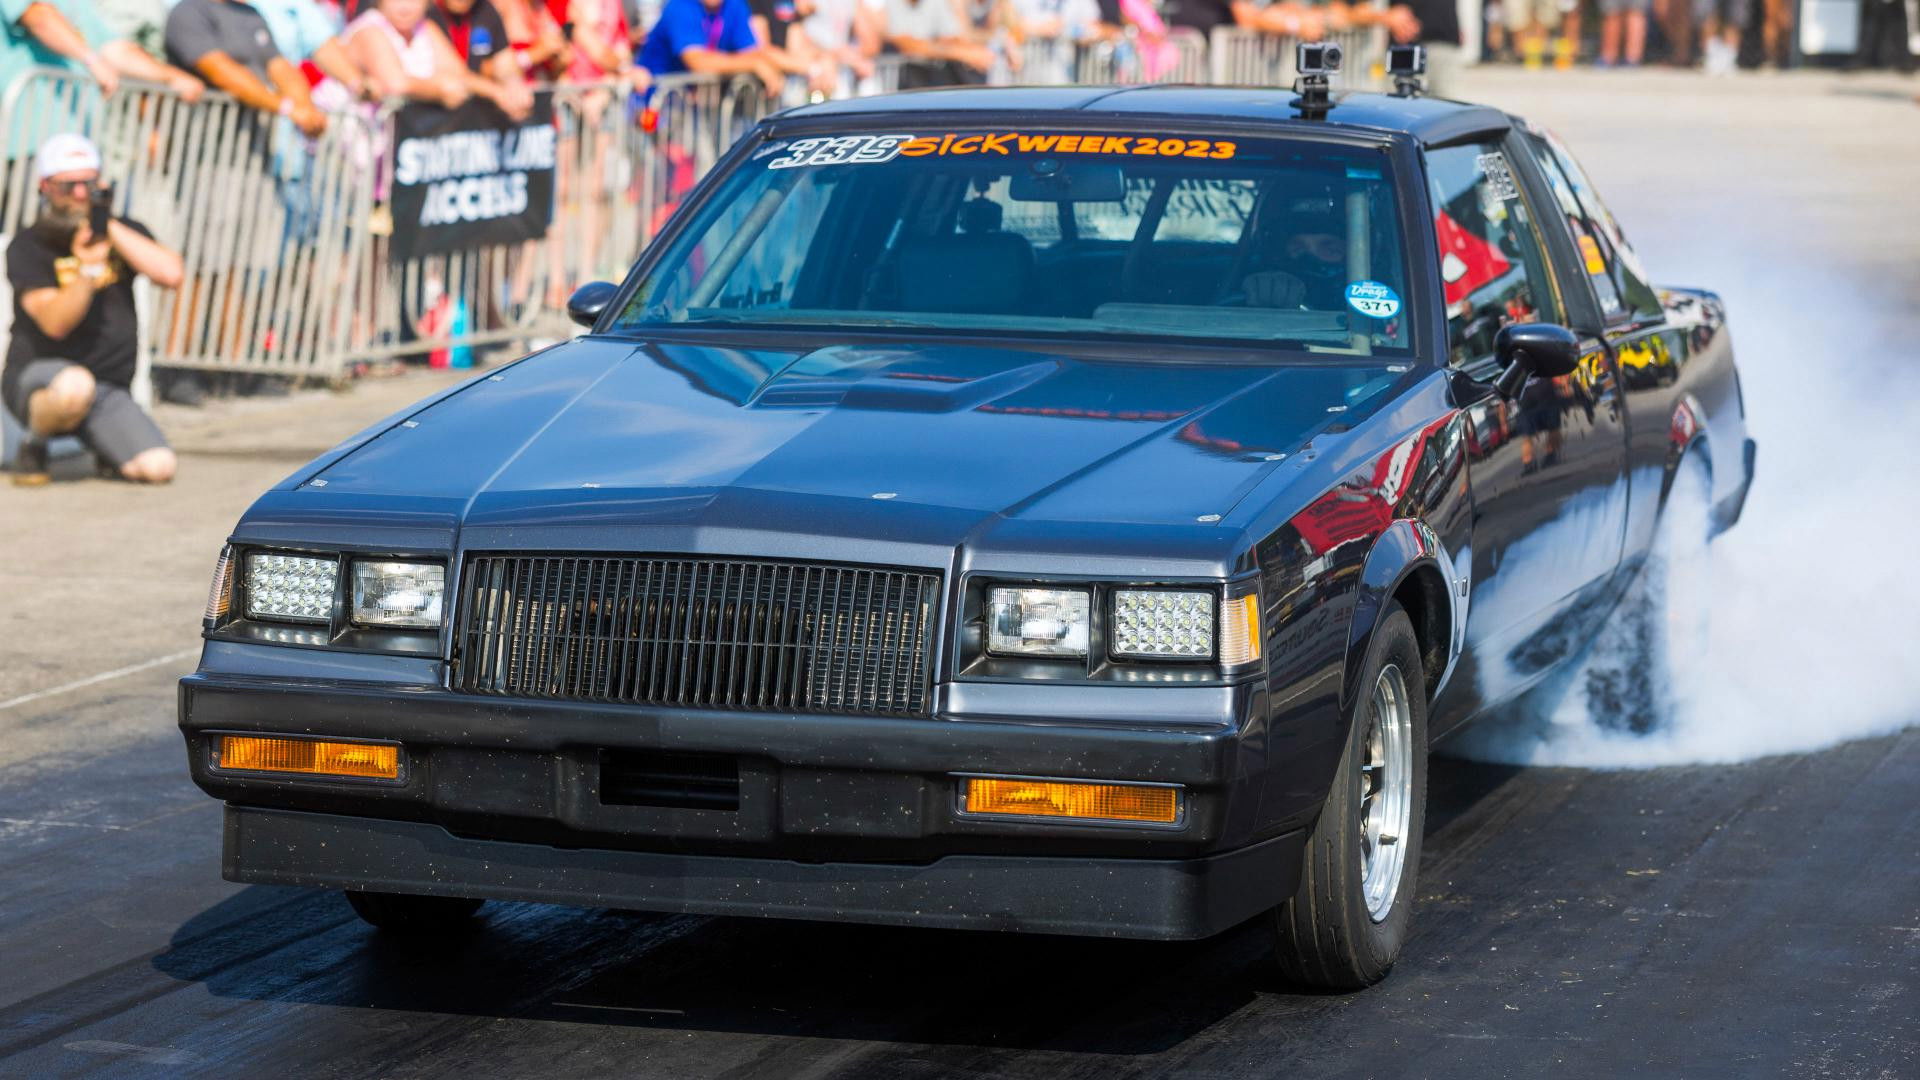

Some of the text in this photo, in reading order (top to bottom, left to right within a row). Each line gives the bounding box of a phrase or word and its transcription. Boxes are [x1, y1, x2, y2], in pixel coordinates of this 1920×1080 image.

[768, 134, 916, 169] 339
[1018, 135, 1134, 154] WEEK
[1132, 137, 1237, 159] 2023
[420, 172, 528, 226] ACCESS
[1360, 300, 1392, 312] 371
